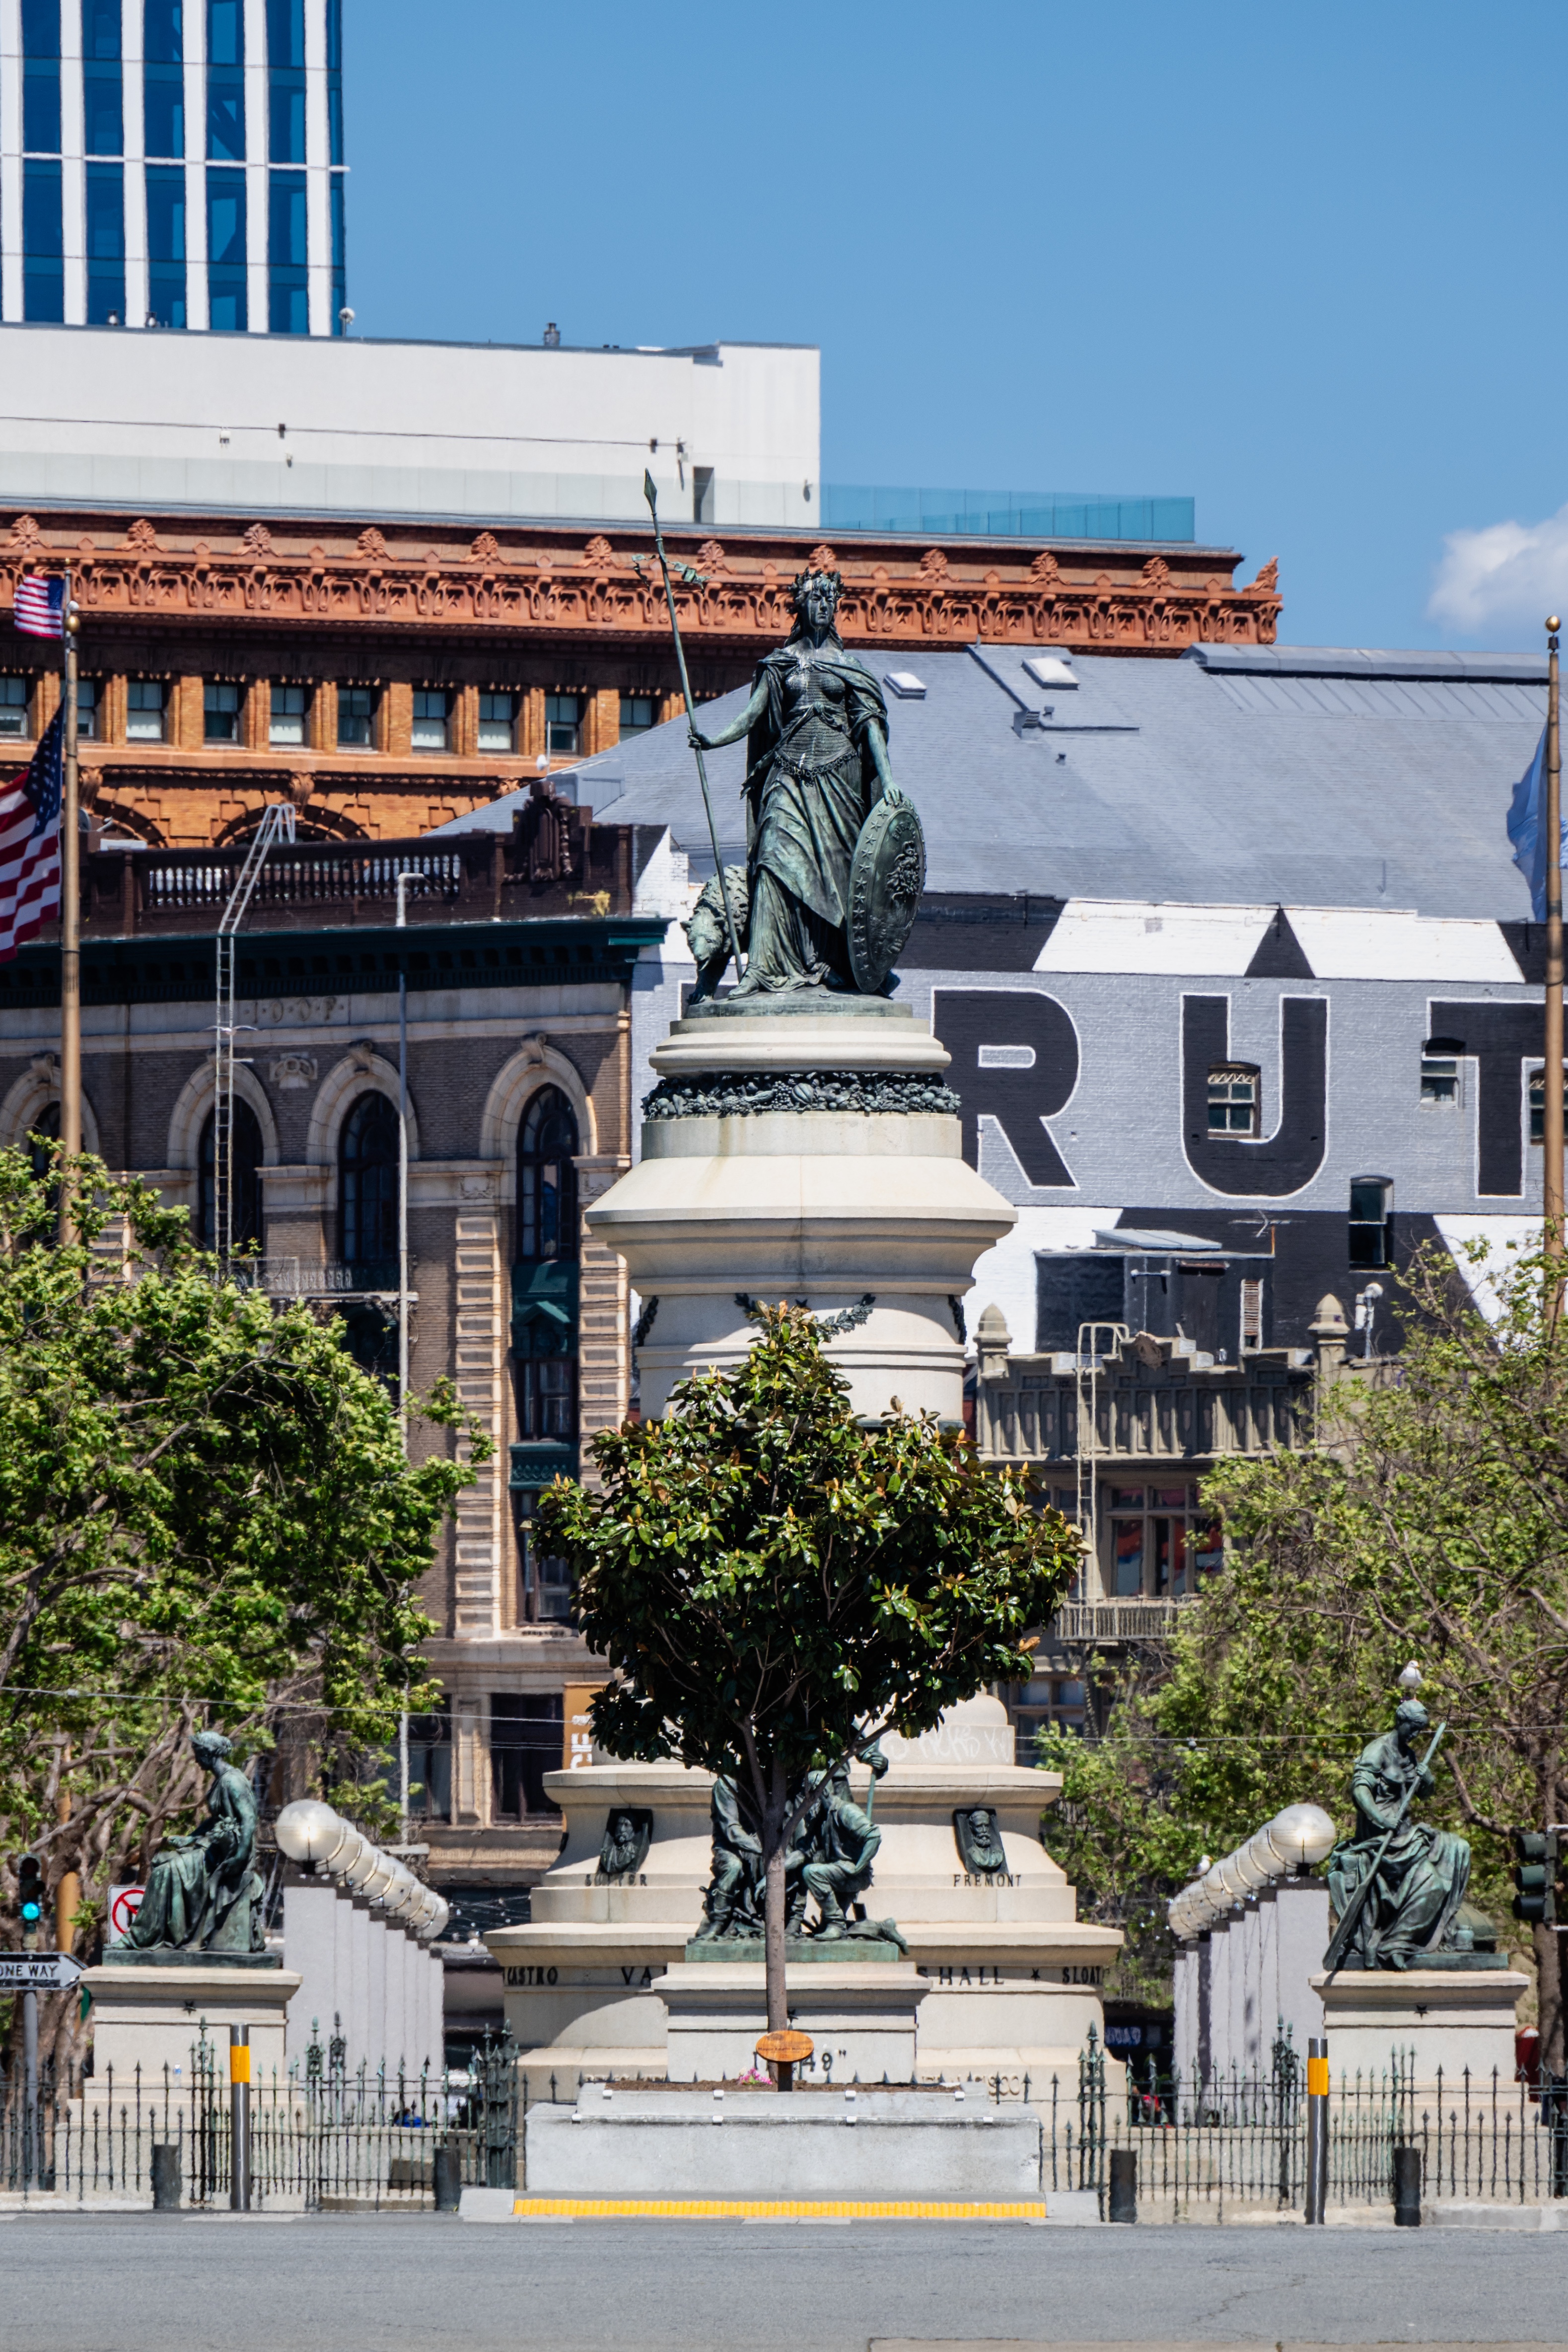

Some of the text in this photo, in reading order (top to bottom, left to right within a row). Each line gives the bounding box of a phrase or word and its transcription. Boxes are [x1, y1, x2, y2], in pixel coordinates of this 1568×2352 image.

[678, 980, 1568, 1199] RUT
[585, 1874, 647, 1887] SUTTER
[953, 1874, 1021, 1887] FREMONT
[28, 1965, 58, 1977] WAY
[507, 1966, 558, 1986] CASTRO
[1063, 1966, 1100, 1985] SLOAT
